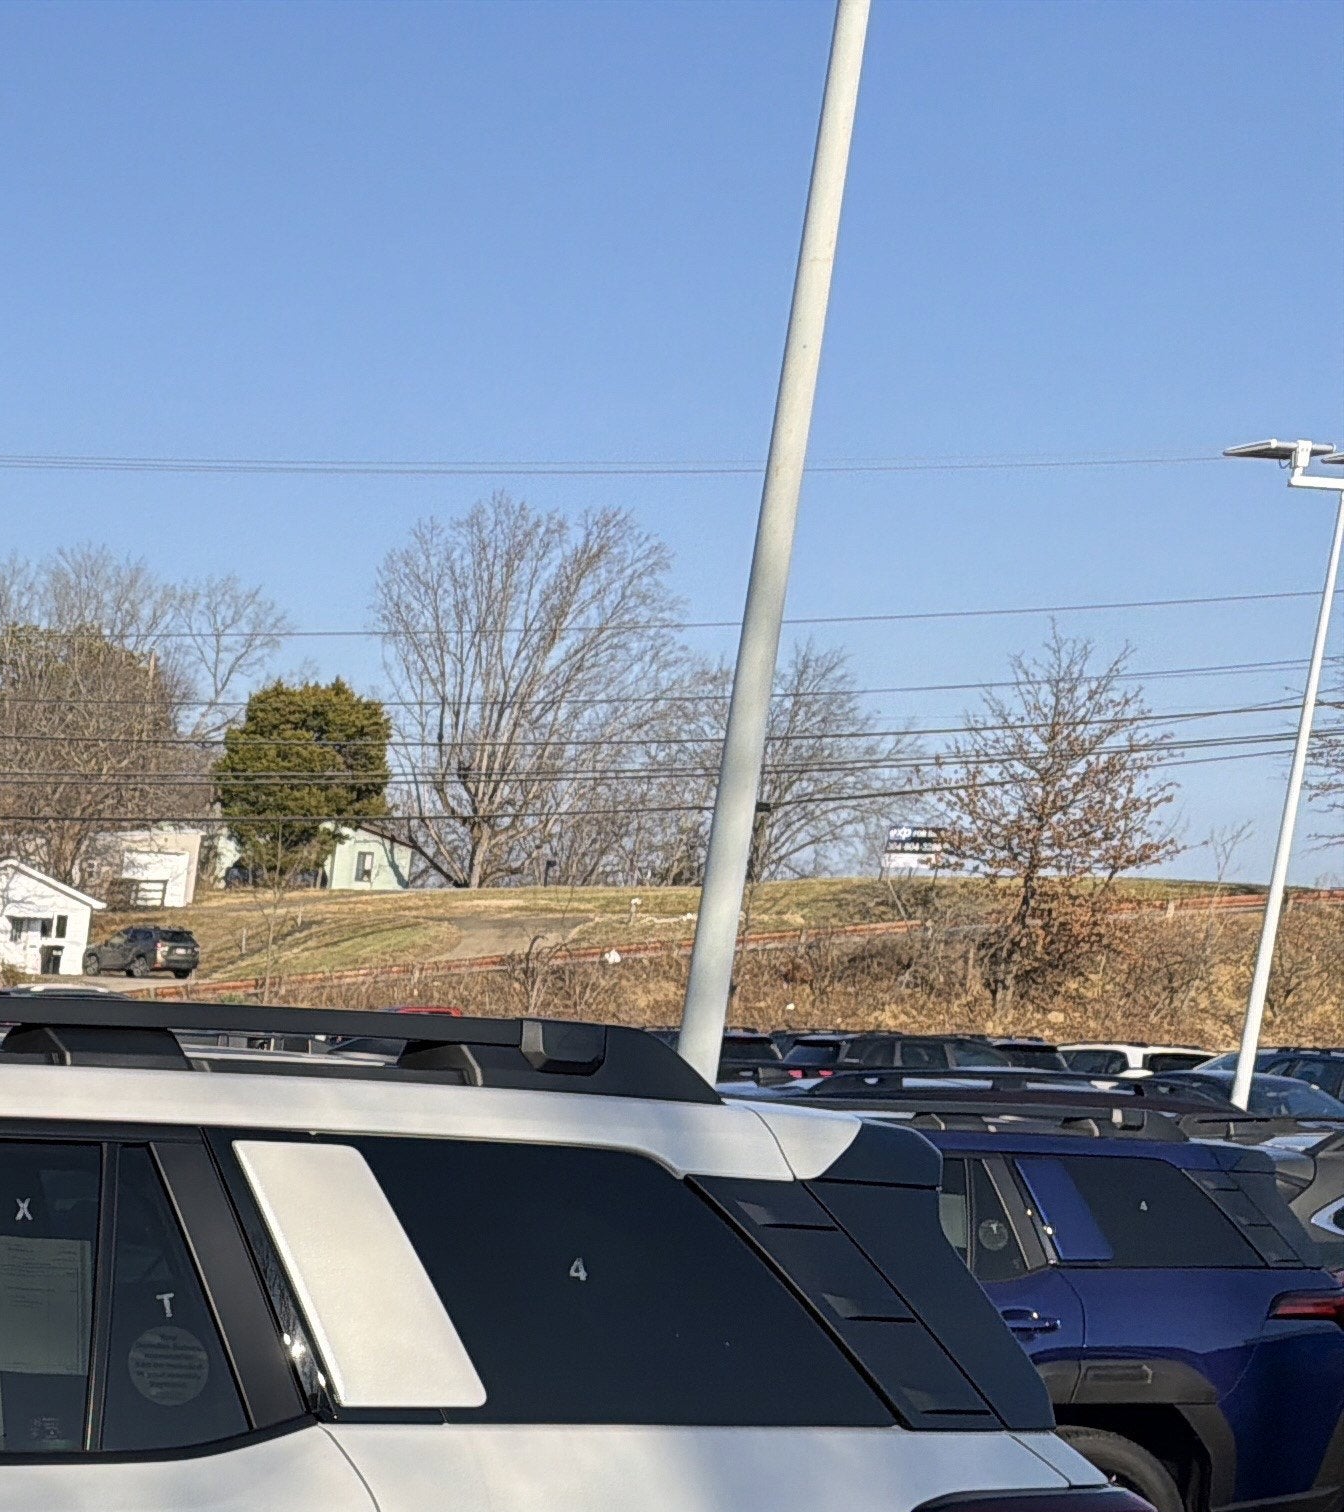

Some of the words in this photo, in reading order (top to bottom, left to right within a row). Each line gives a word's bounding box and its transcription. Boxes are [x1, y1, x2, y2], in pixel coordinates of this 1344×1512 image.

[14, 1197, 34, 1221] X
[568, 1256, 588, 1282] 4
[155, 1292, 175, 1318] T
